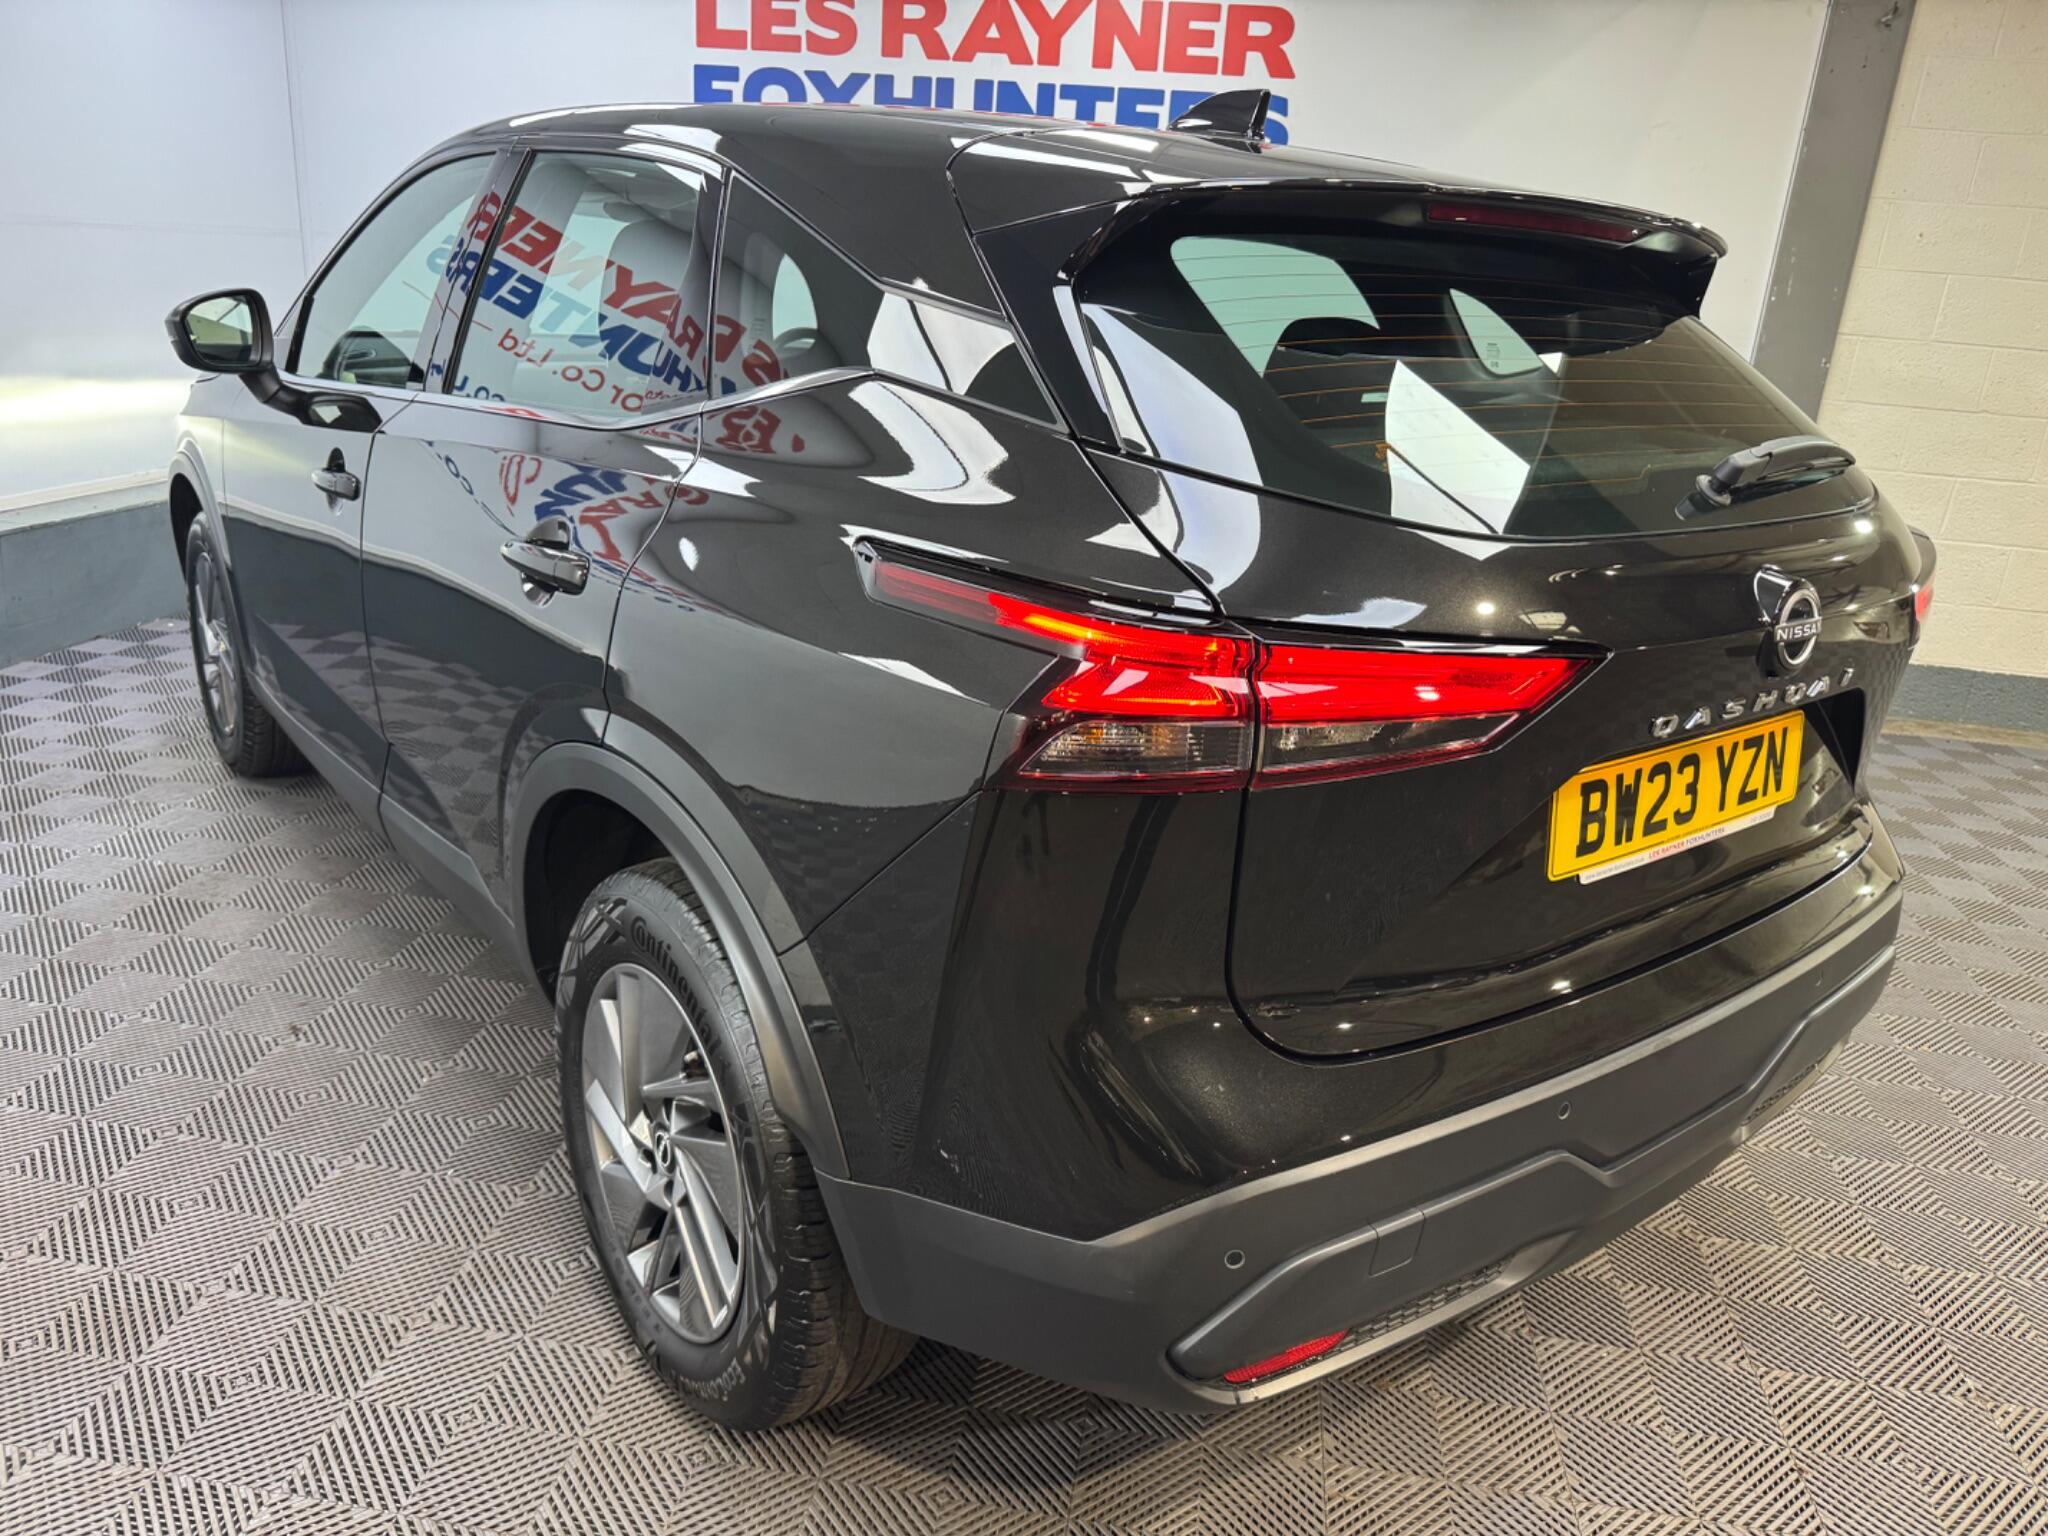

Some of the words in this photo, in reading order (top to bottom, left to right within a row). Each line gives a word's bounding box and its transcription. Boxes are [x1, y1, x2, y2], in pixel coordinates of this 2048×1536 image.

[695, 0, 858, 56] LES
[881, 0, 1296, 79] RAYNER
[693, 64, 1289, 146] FOXHUNTE
[1776, 619, 1821, 641] NISSAN
[1652, 668, 1854, 738] QASHQAI
[1575, 753, 1700, 858] BW23
[1716, 727, 1788, 812] YZN
[631, 916, 722, 1056] Continental
